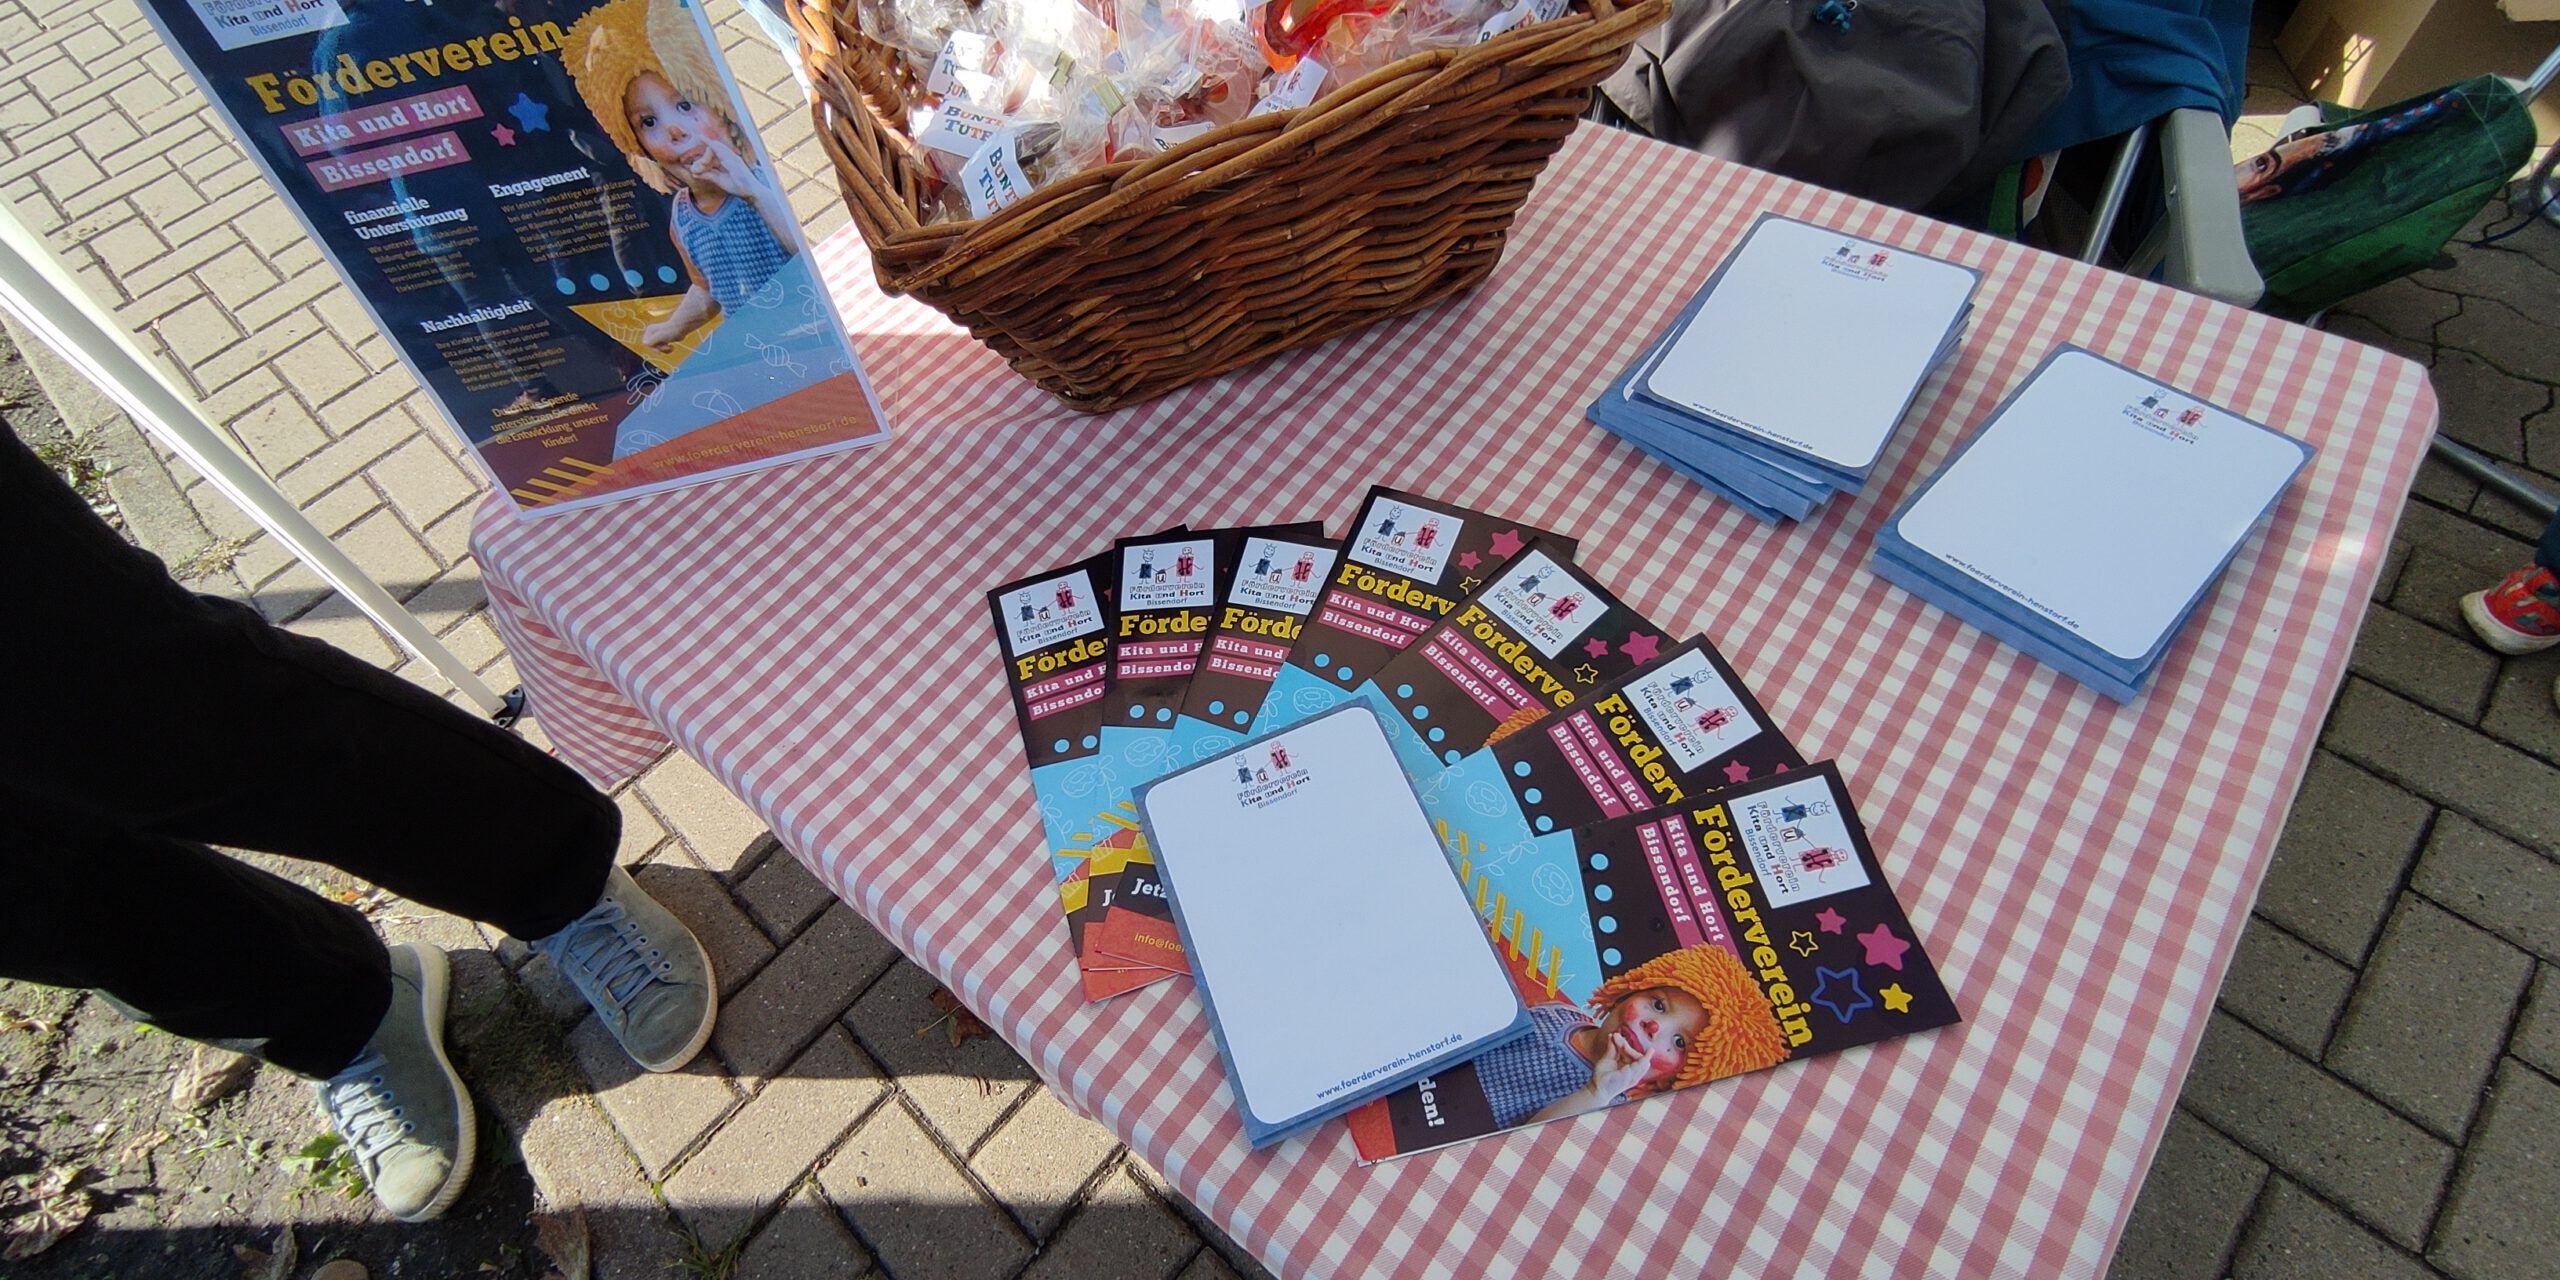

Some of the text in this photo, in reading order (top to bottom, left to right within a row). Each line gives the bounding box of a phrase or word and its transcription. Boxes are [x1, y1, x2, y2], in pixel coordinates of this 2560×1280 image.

[214, 0, 324, 28] Kita und Hort
[249, 14, 309, 36] Bissendorf
[245, 15, 565, 114] Förderverein
[293, 92, 471, 148] Kita und Hort
[320, 137, 457, 185] Bissendorf
[989, 146, 1019, 201] BUNT
[489, 166, 590, 198] Engagement
[344, 197, 430, 224] finanzielle
[420, 300, 533, 333] Nachhaltigkeit
[540, 391, 580, 409] Spende
[567, 402, 599, 415] direkt
[2122, 409, 2143, 422] Kita
[511, 421, 573, 442] Entwicklung
[572, 414, 609, 428] unserer
[541, 433, 578, 449] Kinder!
[653, 414, 858, 470] www.foerderverein-henstorf.de
[1692, 402, 1813, 451] www.foerderverein-henstorf.de
[1361, 544, 1433, 573] Kita und Hort
[1374, 556, 1415, 574] Bissendorf
[1130, 589, 1204, 600] Kita und Hort
[1146, 597, 1188, 607] Bissendorf
[1240, 587, 1314, 605] Kita und Hort
[1255, 597, 1296, 610] Bissendorf
[1945, 552, 2080, 630] www.foerderverein-henstorf.de
[1119, 610, 1211, 637] Förde
[1322, 611, 1407, 646] Bissendorf
[1329, 592, 1431, 633] Kita und Hor
[1494, 592, 1557, 646] Kita und Hort
[1501, 608, 1538, 639] Bissendorf
[1019, 616, 1093, 644] Kita und Hort
[1038, 628, 1078, 645] Bissendorf
[1016, 637, 1109, 681] Förde
[1120, 646, 1153, 657] Kita
[1159, 643, 1188, 655] und
[1216, 639, 1248, 653] Kita
[1254, 645, 1284, 660] und
[1456, 604, 1576, 708] Förderve
[1026, 670, 1094, 699] Kita und
[1425, 645, 1497, 706] Bissendorf
[1439, 630, 1529, 707] Kita und Hort
[1033, 686, 1105, 716] Bissendo
[1640, 687, 1696, 759] Kita und Hort
[1643, 707, 1677, 748] Bissendorf
[1553, 726, 1617, 807] Bissendorf
[1573, 713, 1649, 811] Kita und Hor
[1240, 795, 1262, 808] Kita
[1286, 775, 1311, 789] Hort
[1257, 788, 1298, 809] Bissendorf
[1745, 828, 1771, 877] Bissendorf
[1747, 804, 1789, 895] Kita und Hort
[1757, 800, 1801, 892] Förderverein
[1642, 826, 1692, 924] Bissendorf
[1666, 818, 1725, 942] Kita und Hort
[1693, 803, 1814, 1048] Förderverein
[1316, 1032, 1463, 1100] www.foerderverein-henstorf.de
